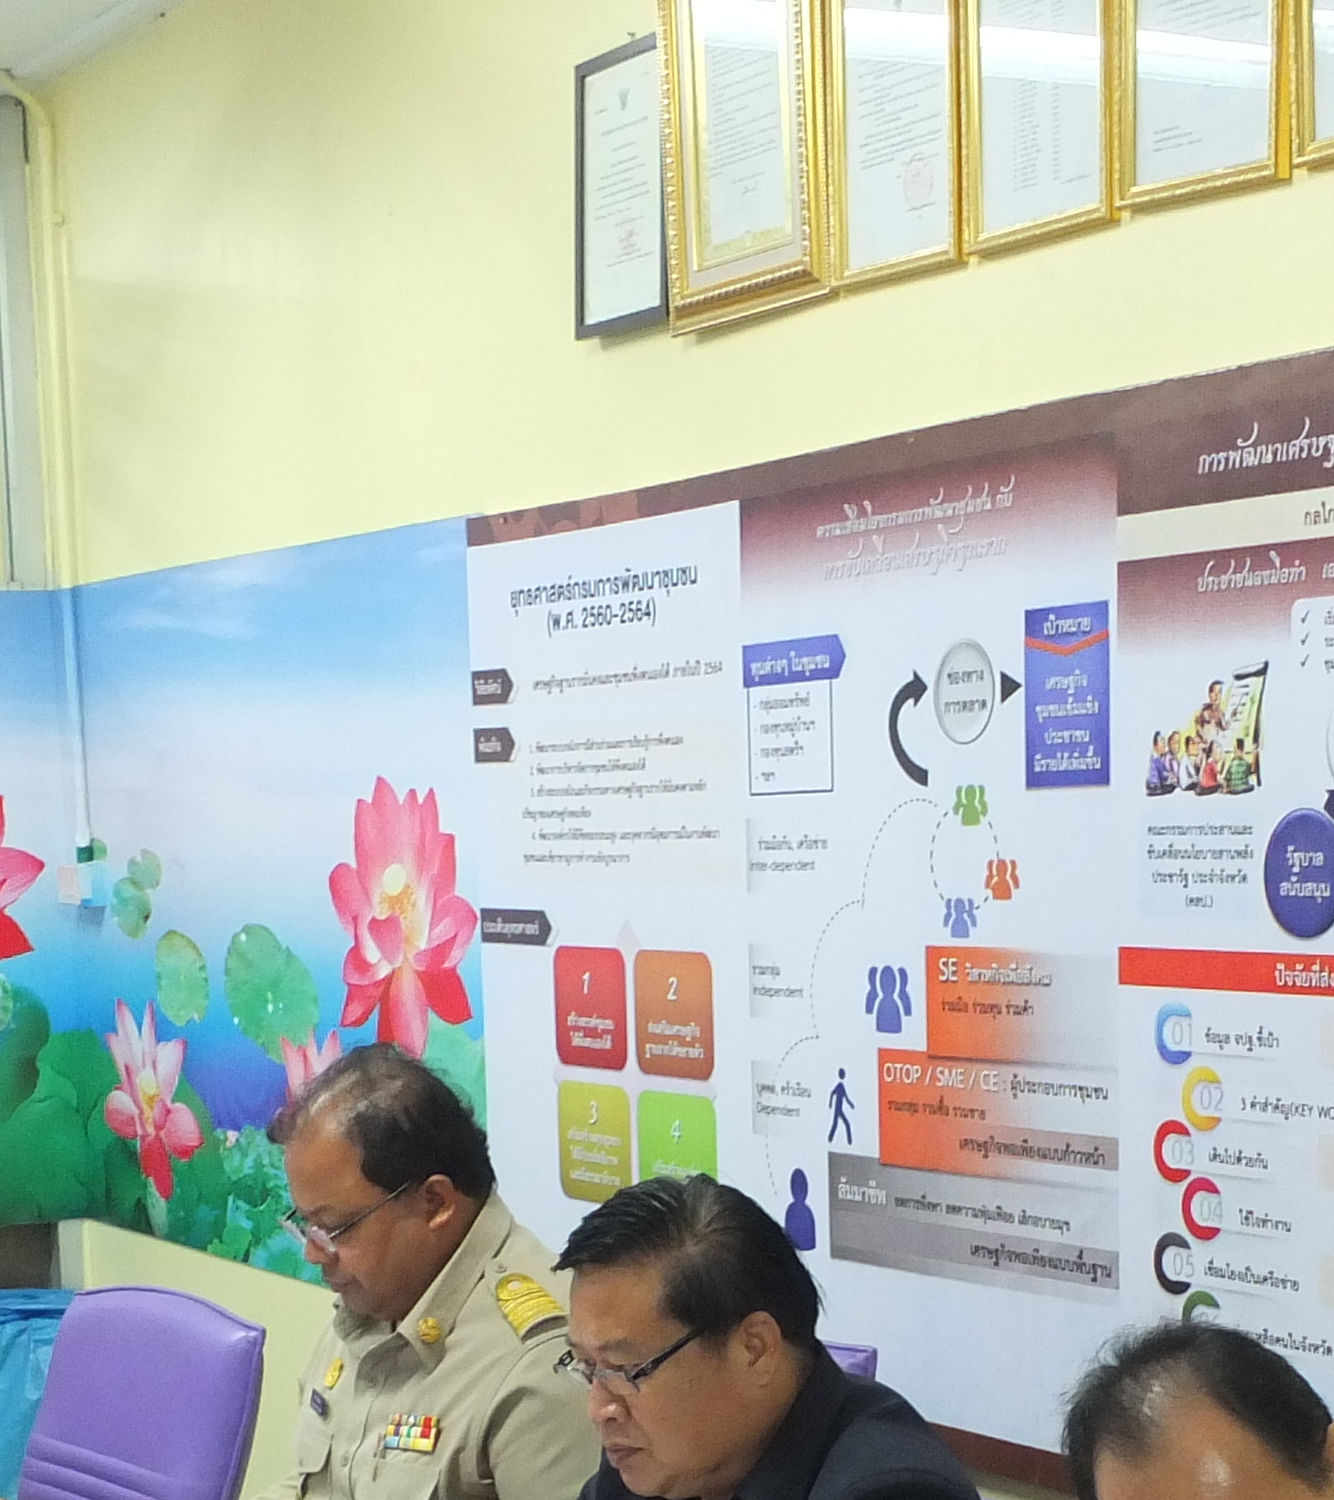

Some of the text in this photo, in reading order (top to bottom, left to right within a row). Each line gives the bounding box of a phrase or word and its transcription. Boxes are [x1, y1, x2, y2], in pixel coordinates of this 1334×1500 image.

[510, 566, 698, 617] ยุทธศาสตร์กรมการพัฒนาชุมชน
[581, 597, 656, 628] 2560-2564)
[1286, 845, 1324, 873] รัฐบาล
[1280, 876, 1330, 903] สนับสนุน
[581, 971, 591, 994] 1
[938, 958, 958, 982] SE
[667, 977, 678, 1000] 2
[883, 1062, 921, 1085] OTOP
[936, 1066, 965, 1089] SME
[980, 1070, 999, 1092] CE
[1010, 1074, 1109, 1104] ผู้ประกอบการชุมชน
[589, 1101, 599, 1125] 3
[671, 1119, 681, 1144] 4
